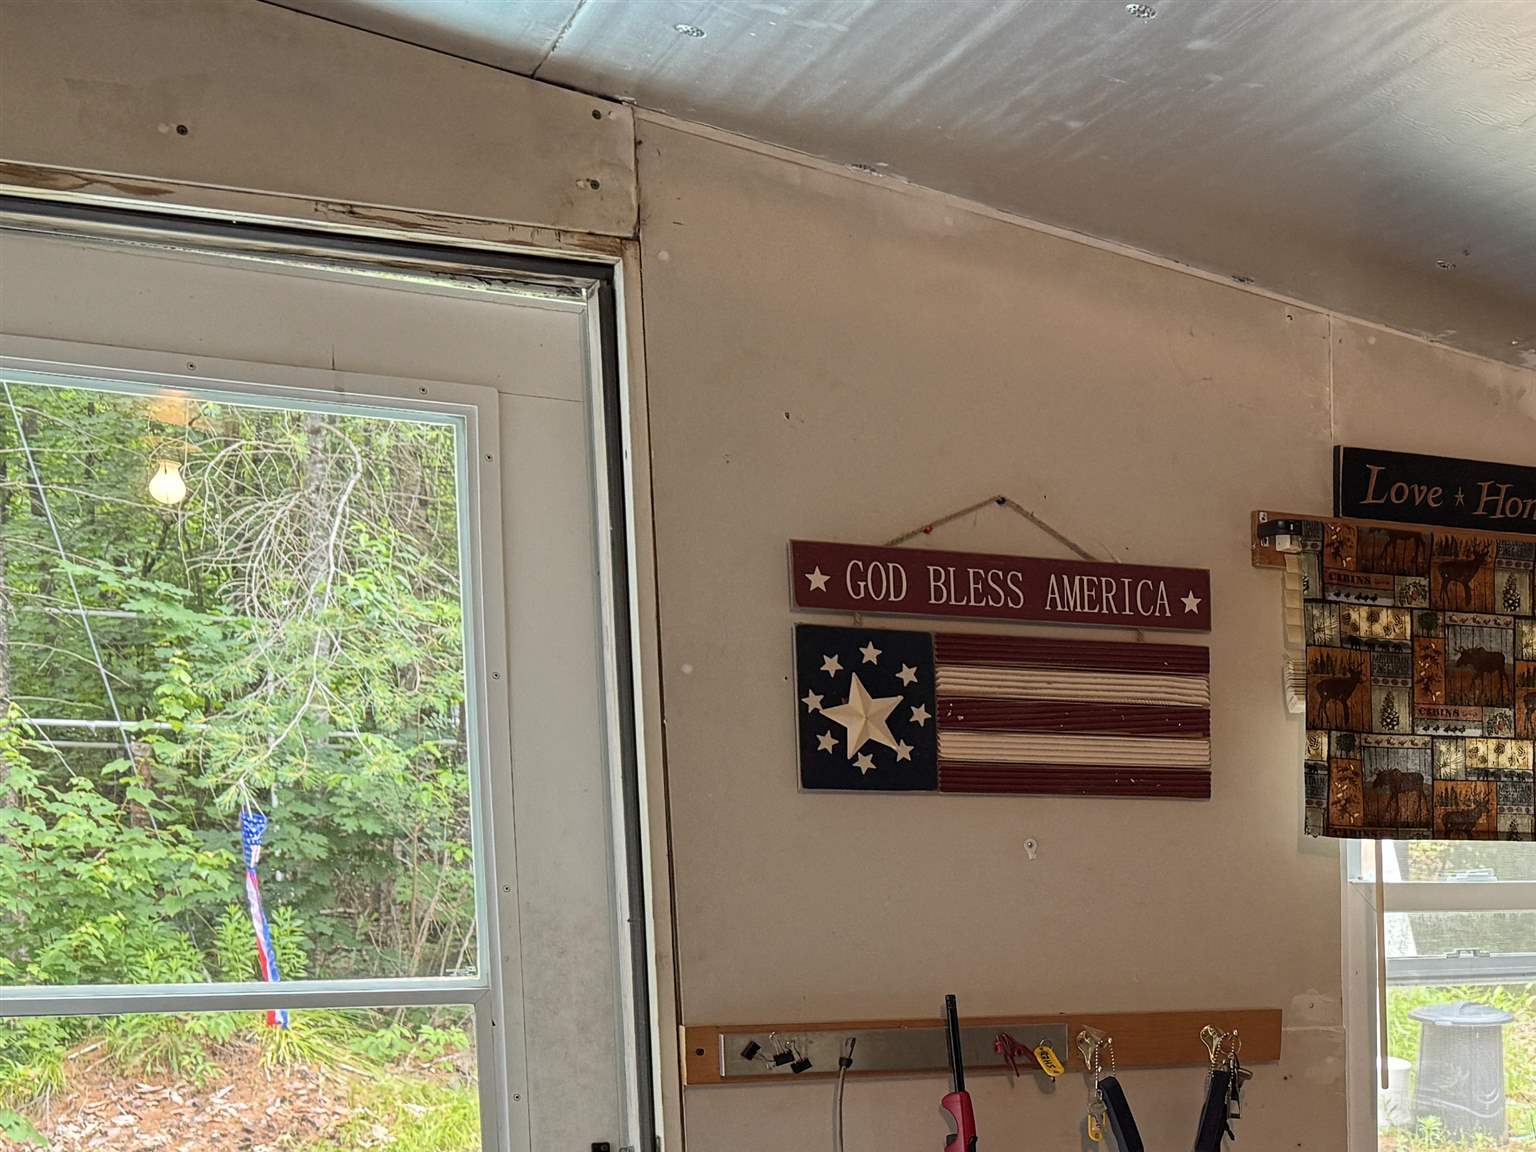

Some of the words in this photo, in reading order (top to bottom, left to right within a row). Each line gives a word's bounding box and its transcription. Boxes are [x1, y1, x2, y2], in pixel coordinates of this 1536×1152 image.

[1360, 464, 1443, 508] Love
[846, 560, 907, 601] GOD
[928, 566, 1025, 608] BLESS
[1045, 573, 1171, 617] AMERICA
